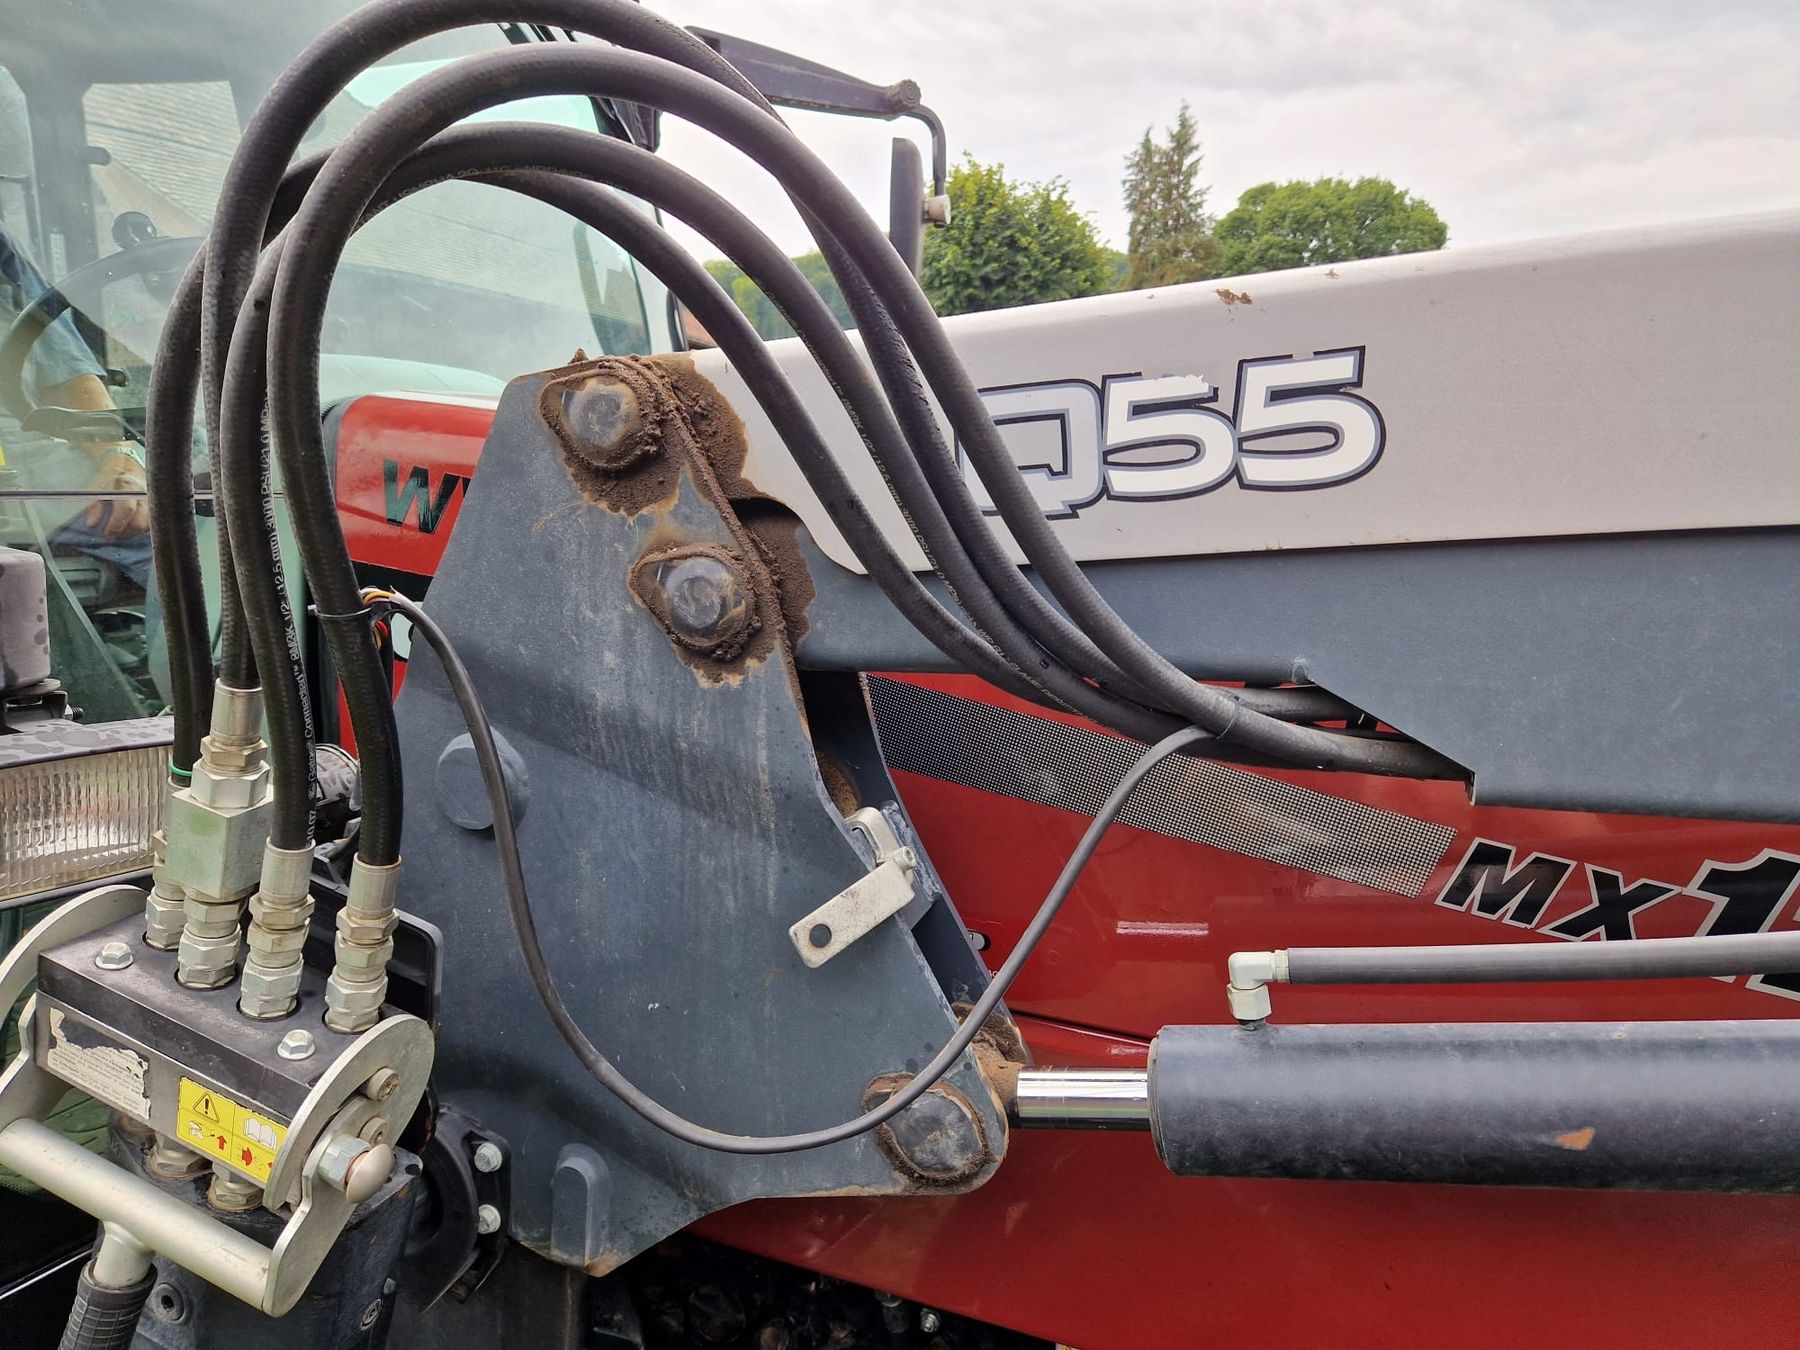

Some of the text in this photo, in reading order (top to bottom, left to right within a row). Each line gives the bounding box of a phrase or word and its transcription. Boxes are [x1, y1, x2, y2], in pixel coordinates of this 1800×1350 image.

[383, 458, 473, 536] W
[954, 345, 1387, 520] Q55
[1434, 836, 1800, 1002] MX1
